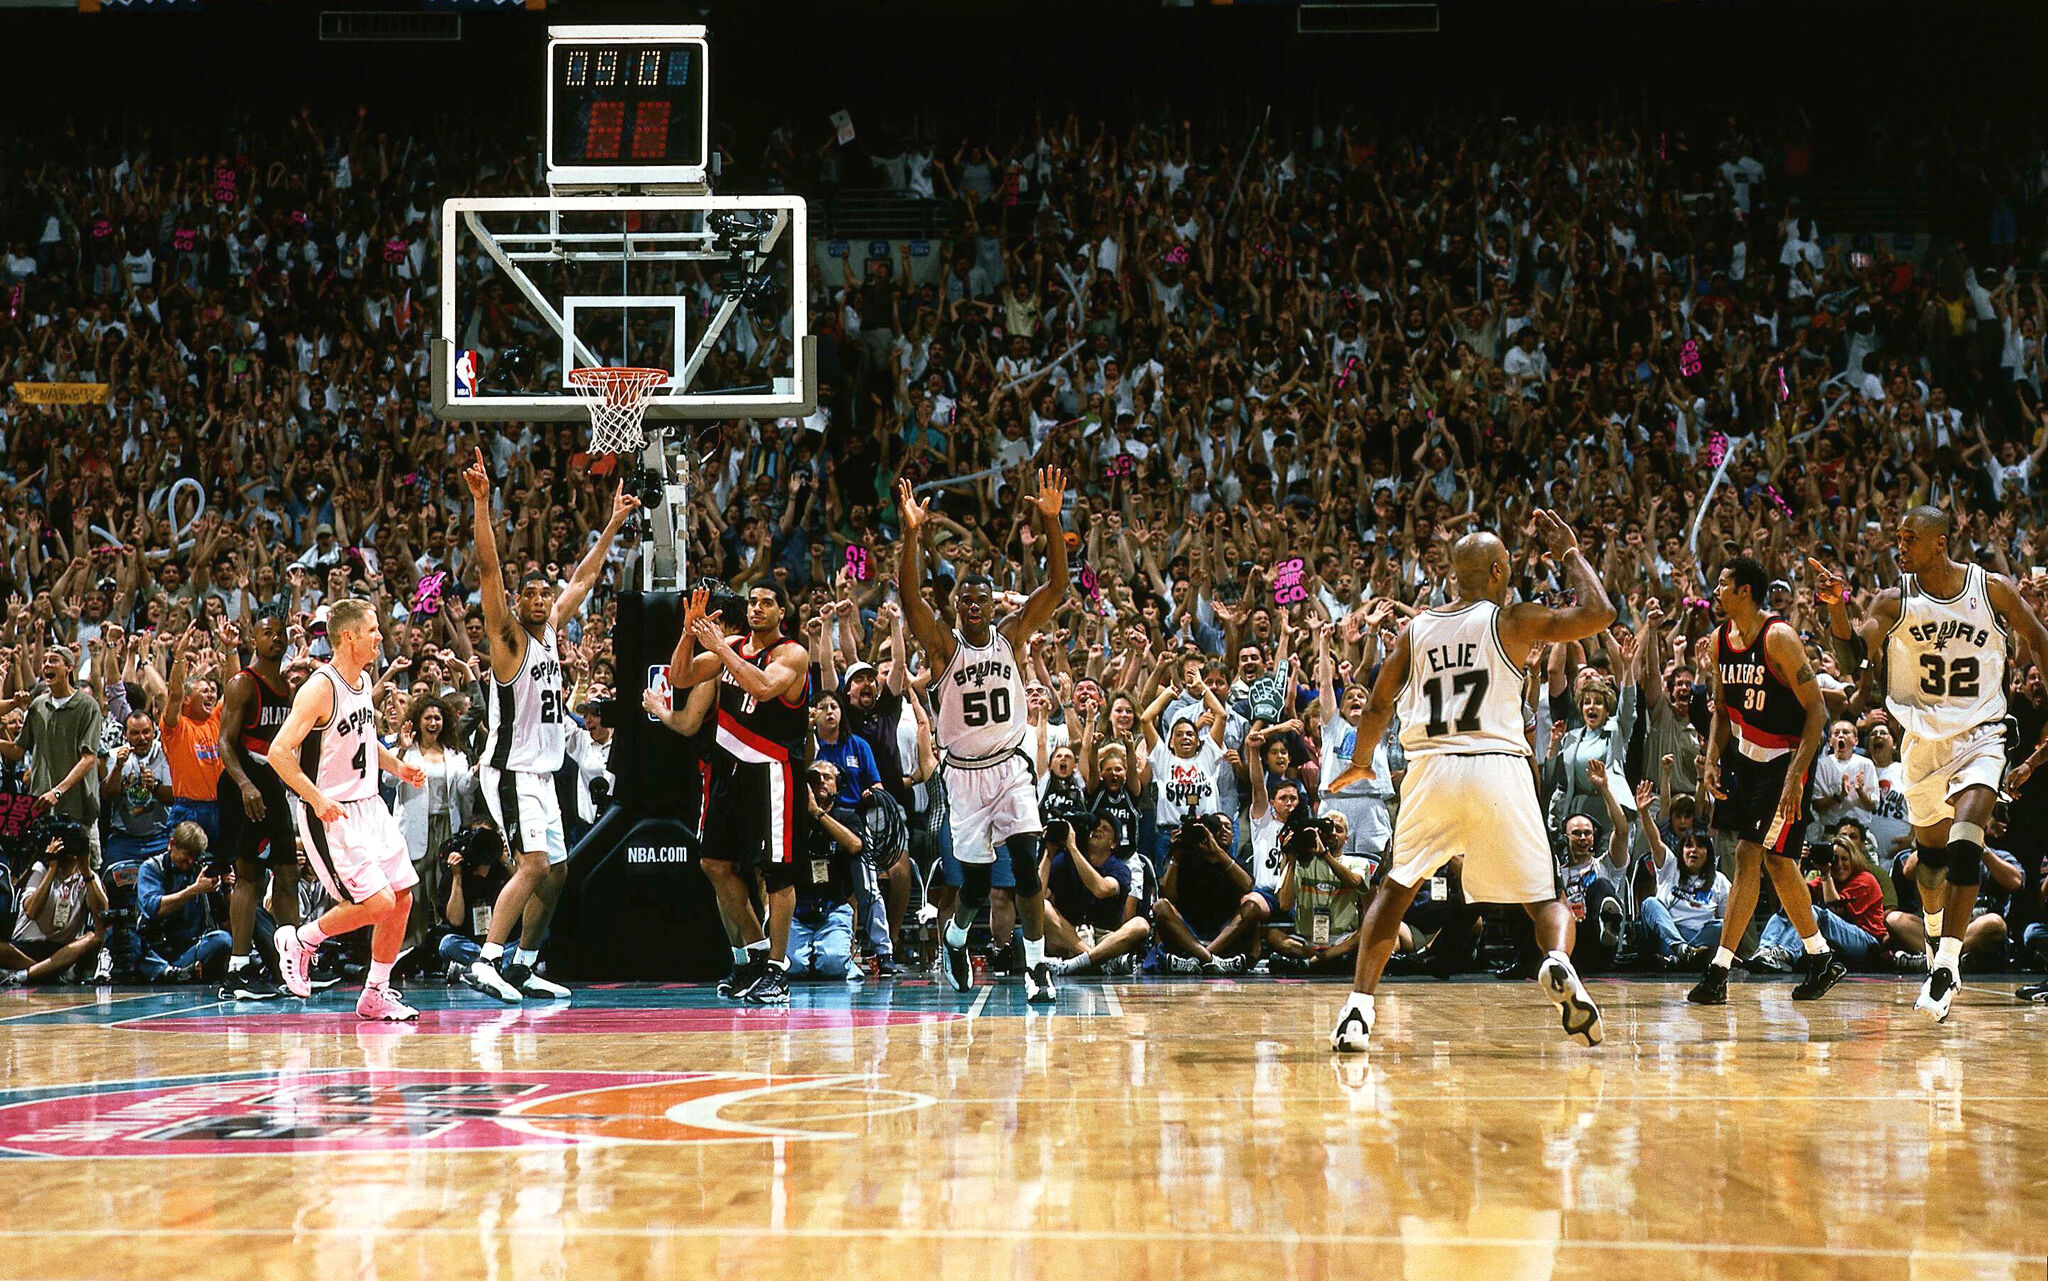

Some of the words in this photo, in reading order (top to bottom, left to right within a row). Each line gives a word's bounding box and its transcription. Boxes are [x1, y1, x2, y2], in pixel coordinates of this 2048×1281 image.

[1274, 585, 1306, 604] GO
[1908, 620, 1989, 648] SPURS
[530, 660, 560, 681] SPUR
[1427, 643, 1477, 673] ELIE
[953, 660, 1011, 687] SPURS
[1919, 653, 1979, 697] 32
[541, 690, 563, 724] 21
[963, 687, 1011, 727] 50
[1423, 669, 1489, 738] 17
[1744, 688, 1766, 711] 30
[260, 706, 292, 727] BLAZ
[336, 706, 377, 737] SPUR
[351, 742, 367, 779] 4
[628, 846, 688, 863] NBA.com
